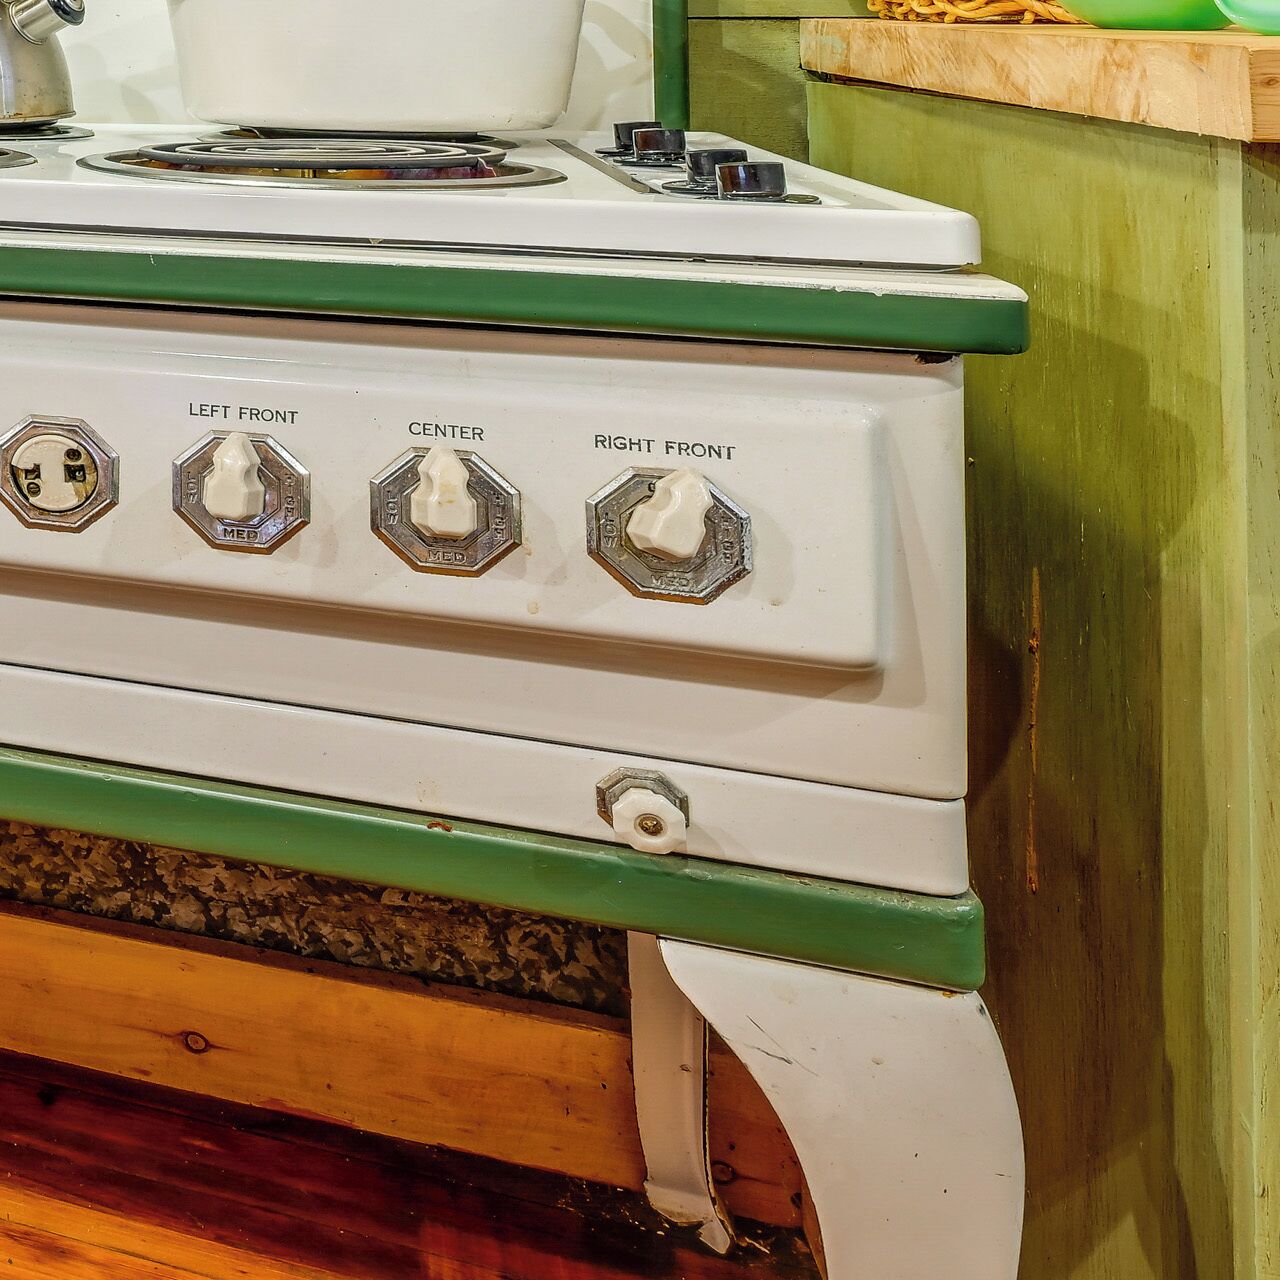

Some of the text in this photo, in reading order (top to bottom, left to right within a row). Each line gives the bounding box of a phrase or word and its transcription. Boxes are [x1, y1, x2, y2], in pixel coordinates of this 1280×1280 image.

[189, 402, 299, 424] LEFT FRONT
[408, 421, 485, 441] CENTER
[594, 434, 736, 460] RIGHT FRONT
[223, 527, 260, 542] MED
[427, 549, 467, 564] MED
